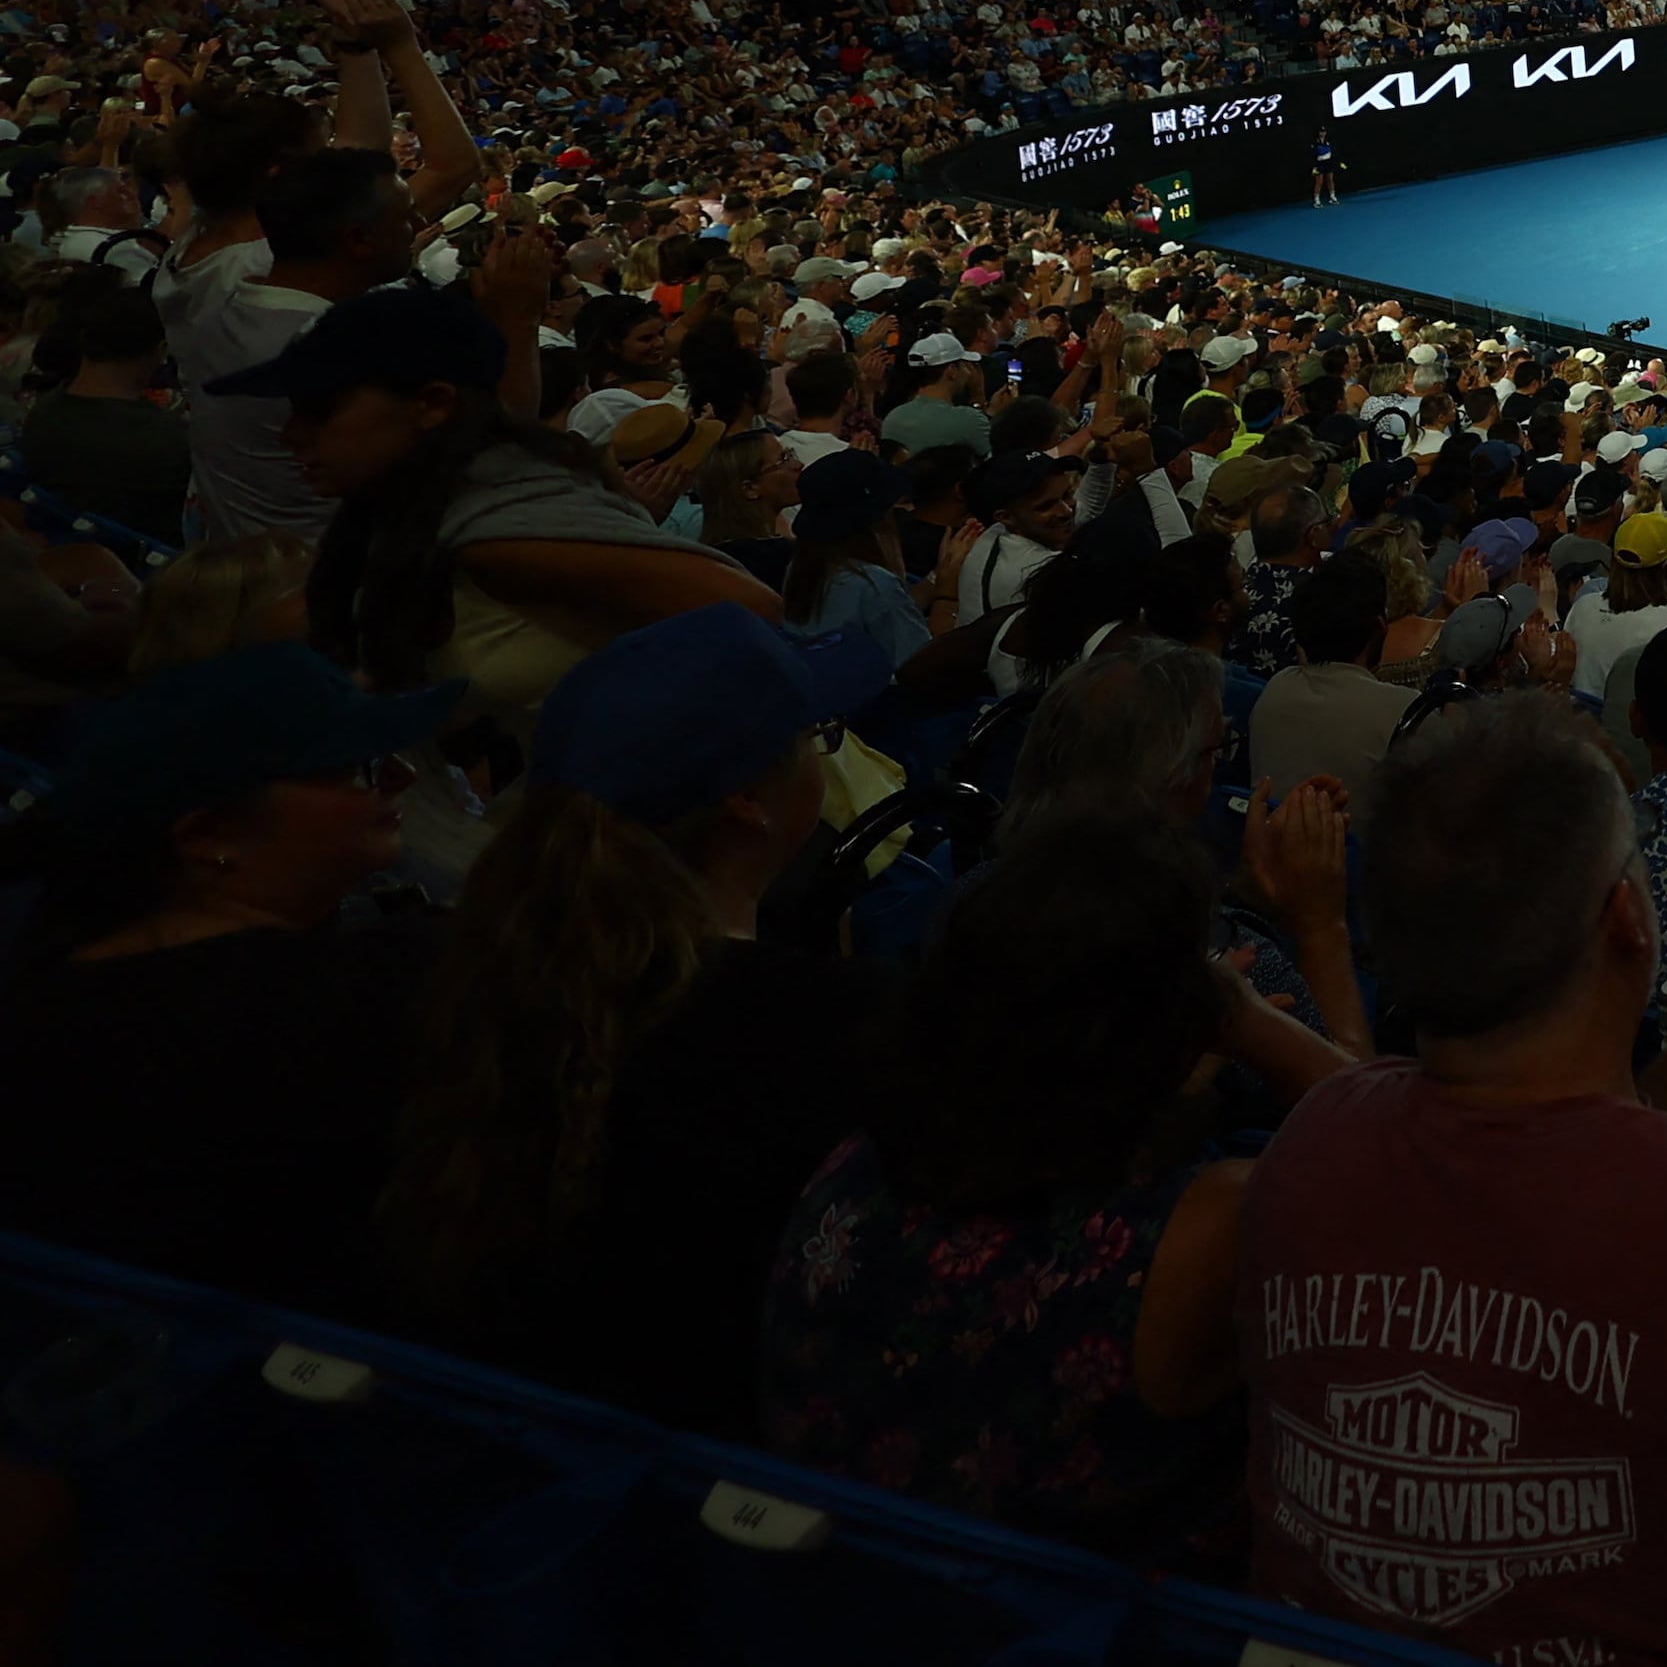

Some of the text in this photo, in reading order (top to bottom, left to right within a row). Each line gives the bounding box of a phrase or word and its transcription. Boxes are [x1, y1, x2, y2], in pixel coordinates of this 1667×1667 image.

[1332, 62, 1470, 117] KIA
[1513, 38, 1635, 88] KIA
[1153, 114, 1284, 147] GUOJIAO 1573
[1021, 145, 1117, 182] GUOJIAO 1573
[1170, 203, 1190, 222] 1:43
[1264, 1267, 1640, 1415] HARLEY-DAVIDSON
[1341, 1394, 1493, 1459] MOTOR
[1279, 1434, 1610, 1543] HARLEY-DAVIDSON
[1273, 1502, 1624, 1579] TRADE MARK
[1331, 1551, 1494, 1618] CYCLES
